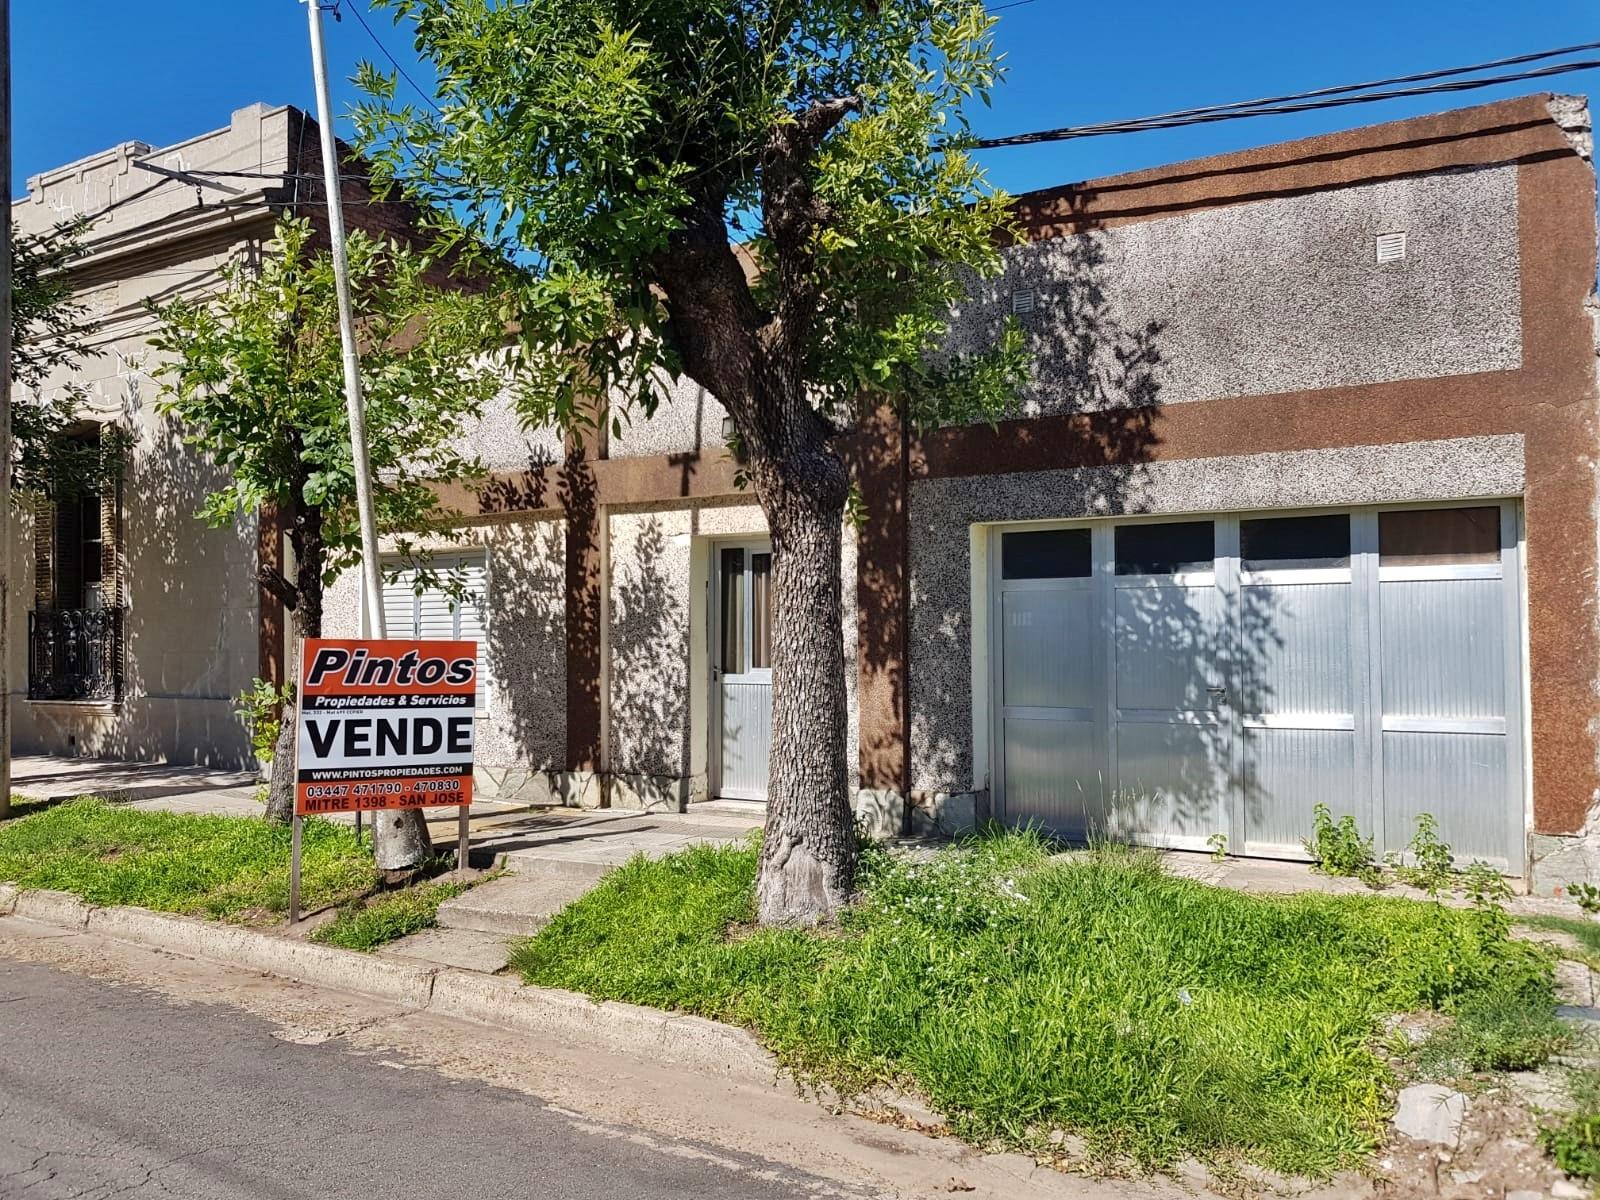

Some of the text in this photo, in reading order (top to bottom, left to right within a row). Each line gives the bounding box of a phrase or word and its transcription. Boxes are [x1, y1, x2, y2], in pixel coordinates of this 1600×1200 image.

[306, 648, 476, 686] Pintos
[315, 695, 466, 709] Propiedades & Servicios
[305, 717, 473, 758] VENDE
[312, 766, 463, 780] WWW.PINTOSPROPIEDADES.COM
[306, 786, 349, 798] 03447
[352, 783, 402, 796] 471790
[413, 780, 460, 792] 470830
[305, 797, 349, 811] MITRE
[355, 796, 387, 809] 1398
[399, 793, 426, 806] SAN
[431, 791, 464, 804] JOSE
